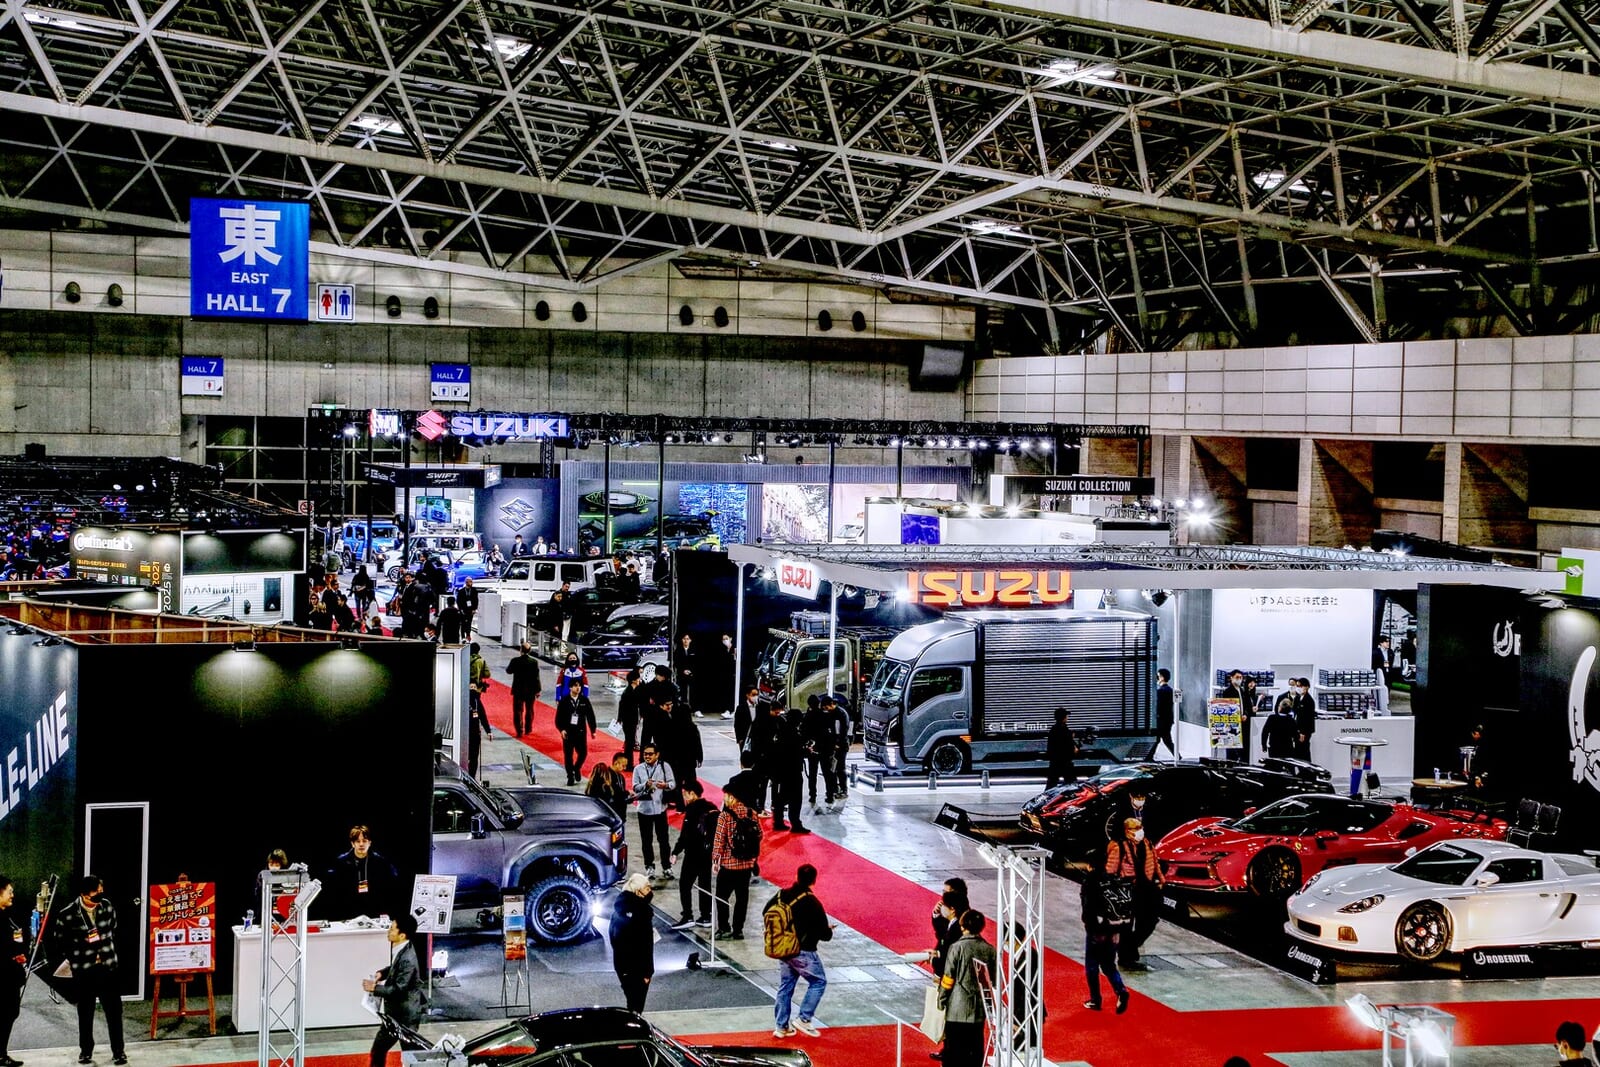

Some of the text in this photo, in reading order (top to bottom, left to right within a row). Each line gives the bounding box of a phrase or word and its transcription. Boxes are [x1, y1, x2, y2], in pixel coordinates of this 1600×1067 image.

[218, 204, 282, 266] 東
[231, 272, 269, 284] EAST
[206, 288, 292, 313] HALL 7
[208, 361, 217, 373] 7
[436, 368, 464, 380] HALL 7
[451, 416, 567, 437] SUZUKI
[1045, 480, 1131, 492] SUZUKI COLLECTION
[782, 564, 812, 590] ISUZU
[907, 571, 1072, 604] ISUZU
[163, 581, 172, 611] 2025
